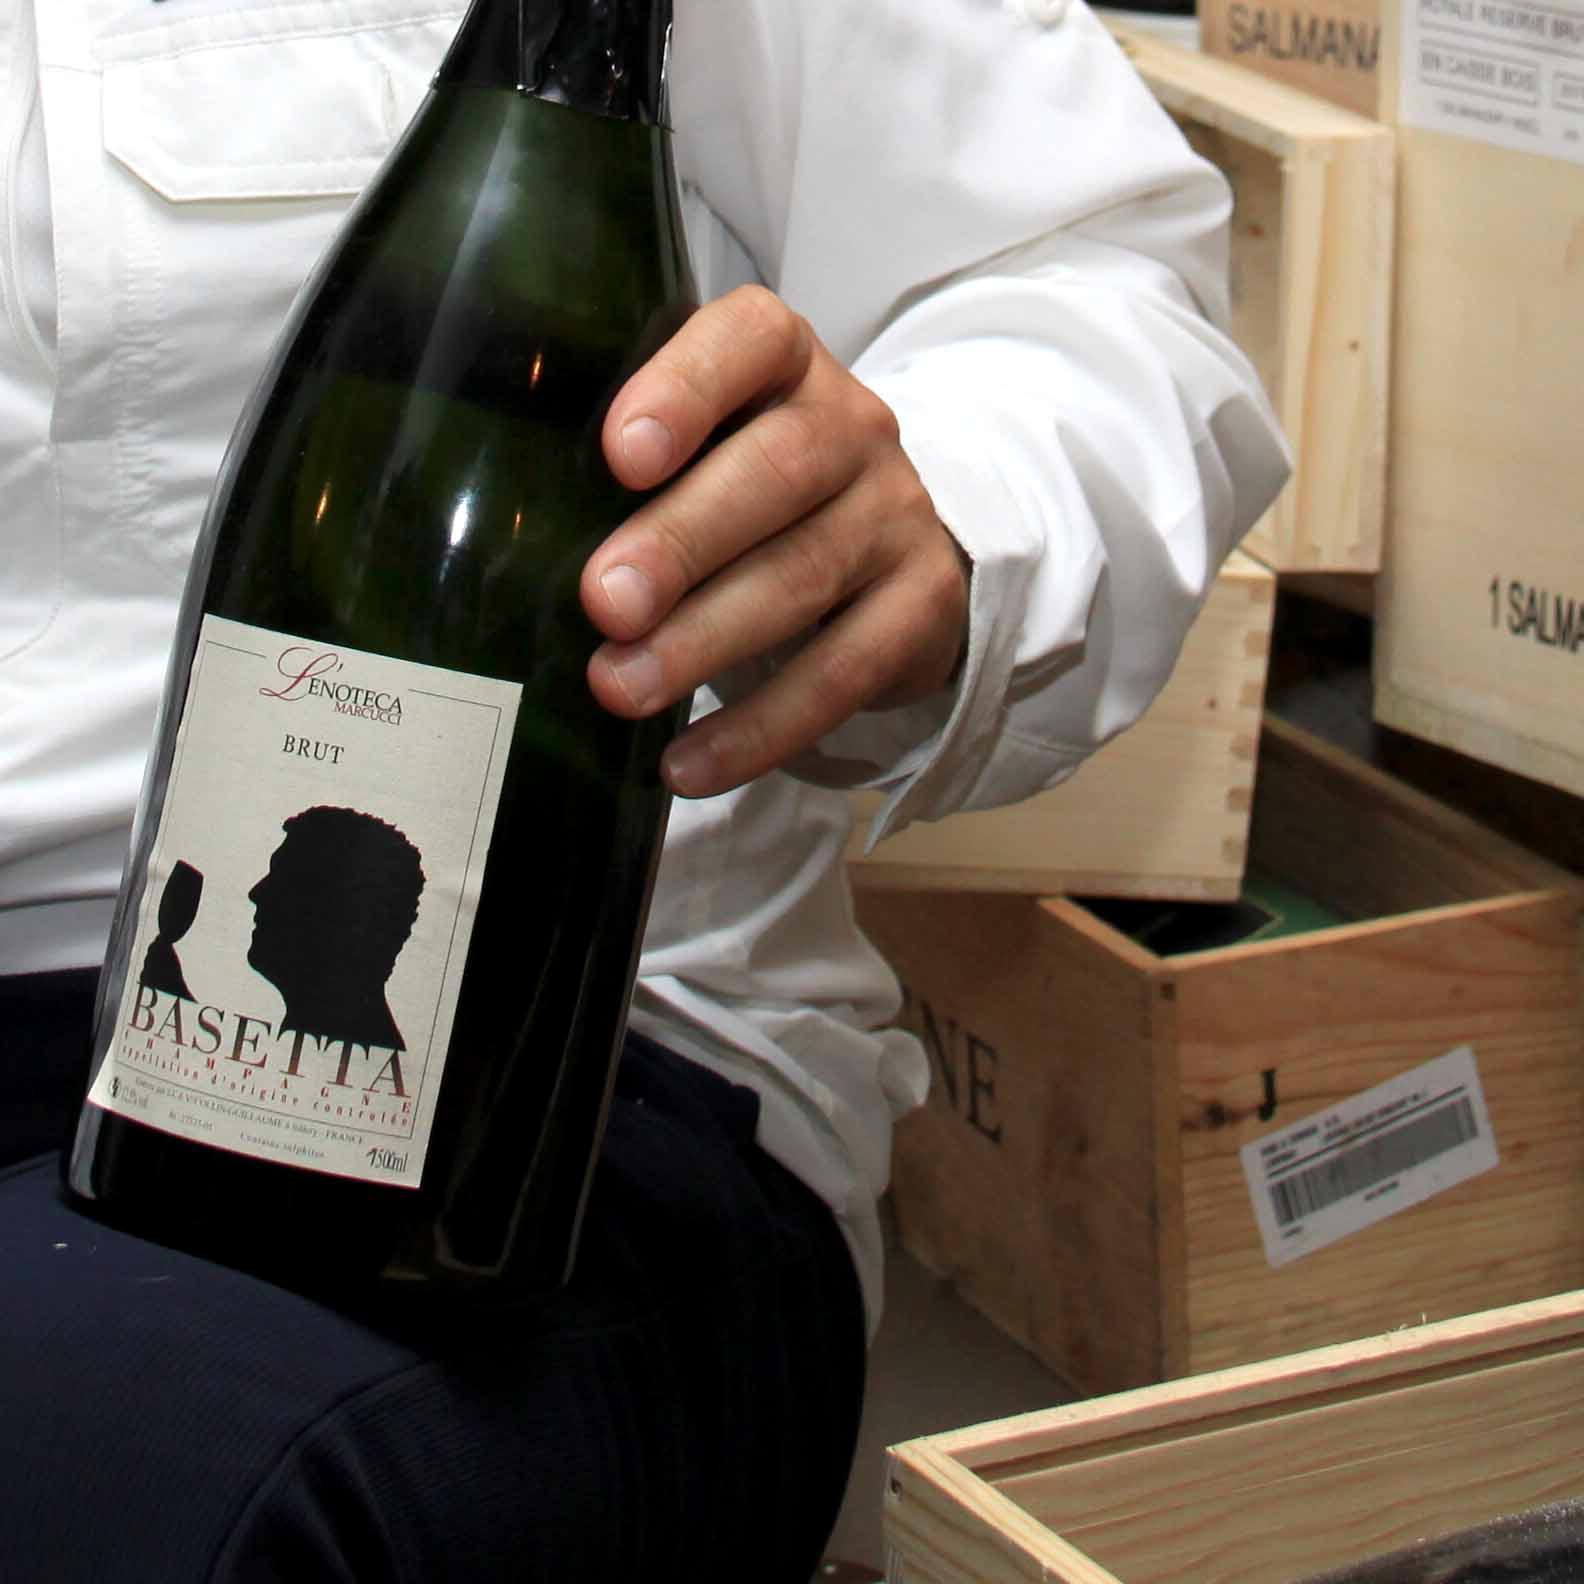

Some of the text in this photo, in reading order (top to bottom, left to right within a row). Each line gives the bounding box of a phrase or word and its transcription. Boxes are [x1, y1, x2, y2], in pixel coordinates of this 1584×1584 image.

[334, 702, 402, 726] MARCUCCI
[282, 733, 345, 765] BRUT
[128, 985, 412, 1098] BASETTA
